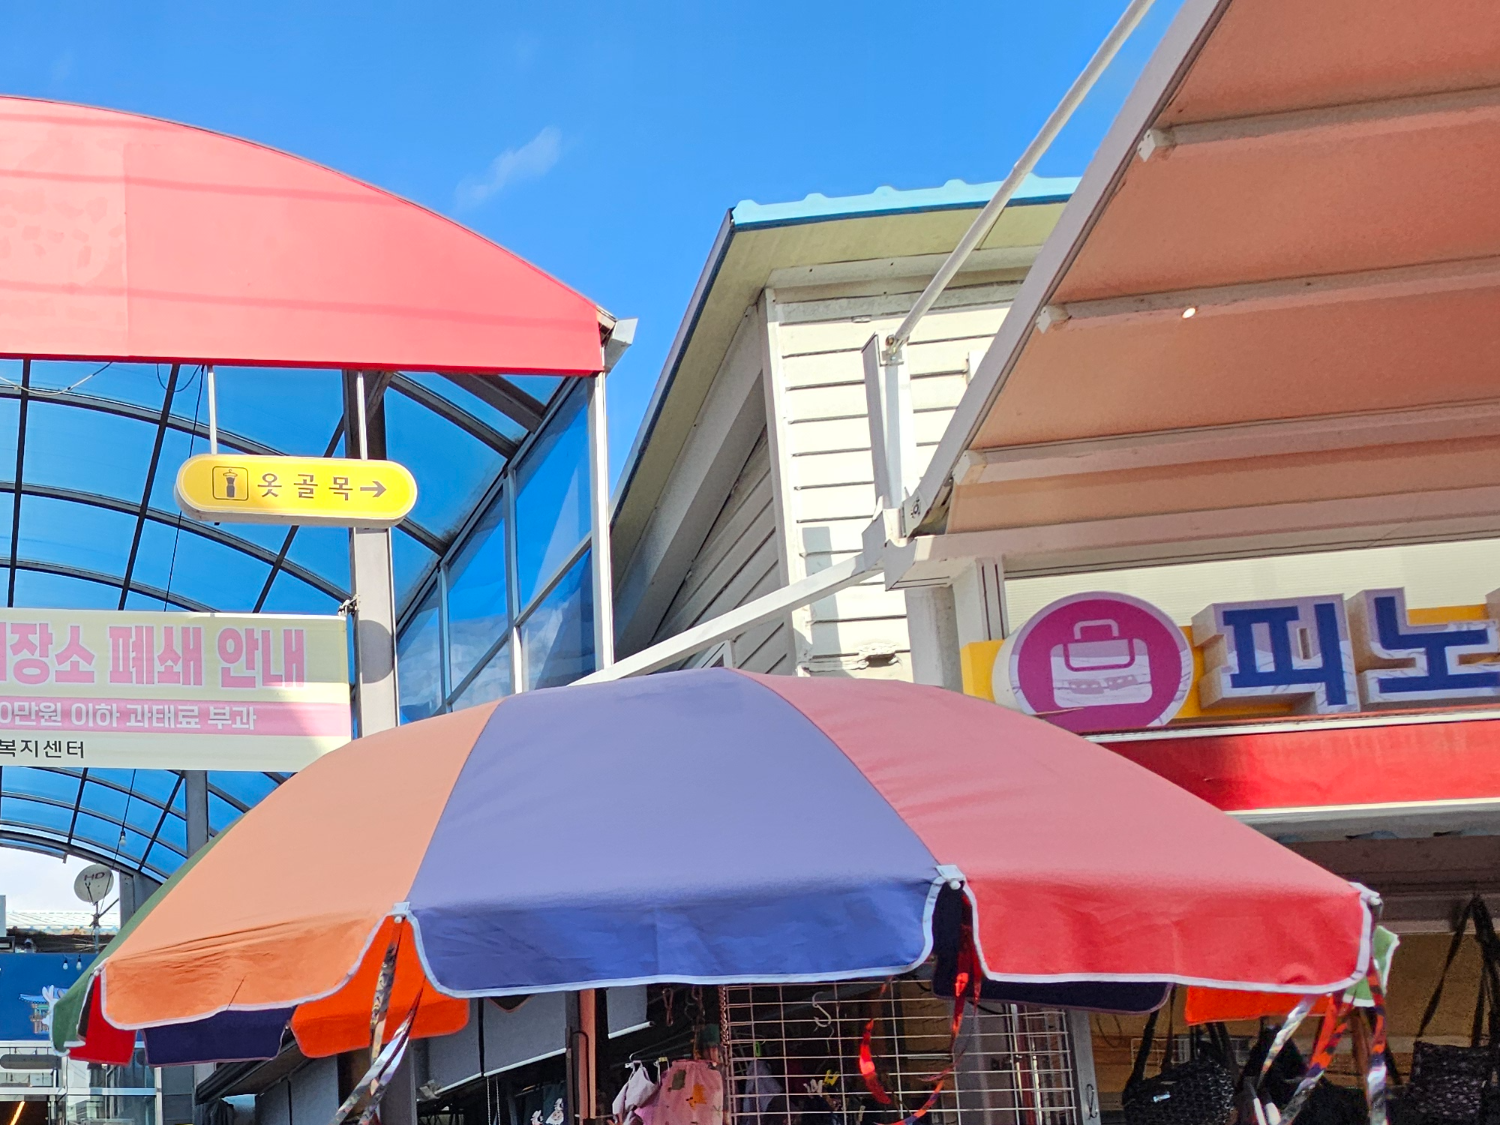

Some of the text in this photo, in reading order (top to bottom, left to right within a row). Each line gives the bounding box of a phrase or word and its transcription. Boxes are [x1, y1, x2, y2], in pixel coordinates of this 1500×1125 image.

[108, 624, 204, 687] 폐쇄
[216, 626, 305, 689] 안내
[71, 703, 120, 728] 이하
[126, 704, 202, 729] 과태료
[207, 705, 257, 730] 부과
